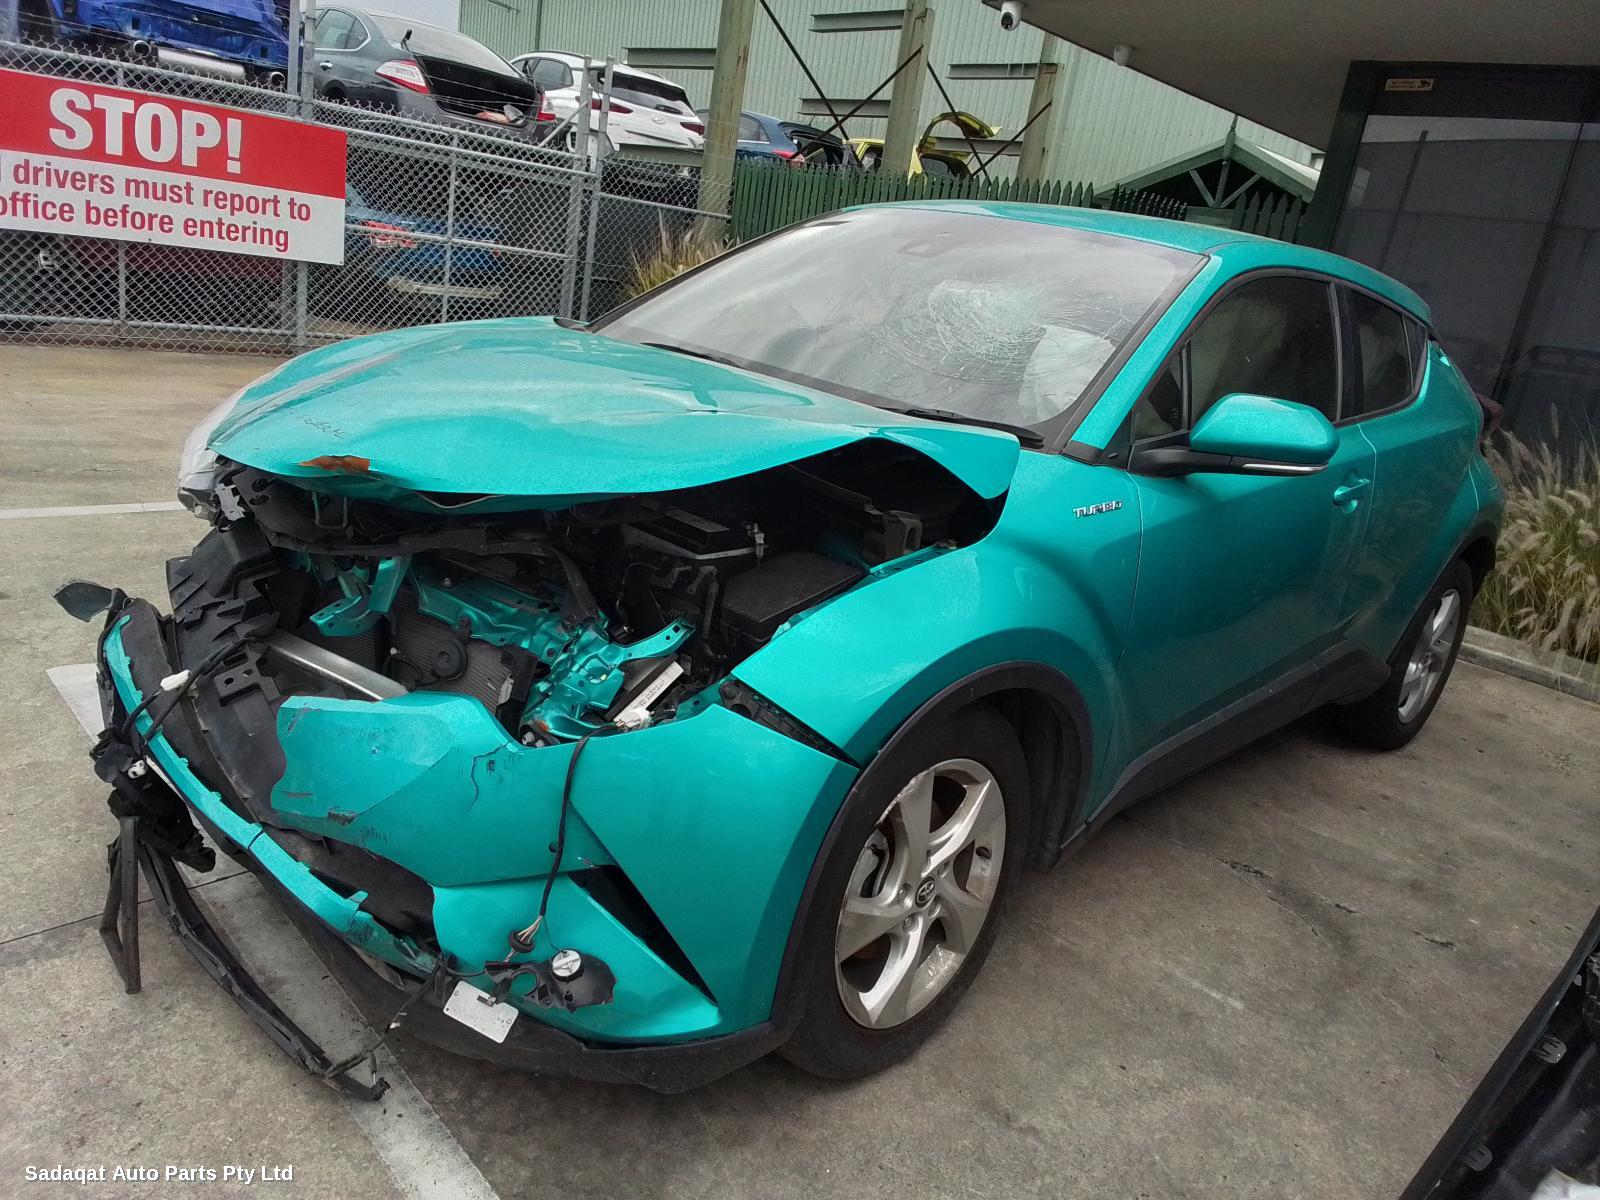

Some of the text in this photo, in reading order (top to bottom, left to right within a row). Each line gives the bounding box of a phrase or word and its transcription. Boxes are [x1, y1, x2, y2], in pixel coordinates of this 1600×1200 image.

[49, 87, 242, 174] STOP!
[13, 159, 312, 222] drivers must report to
[85, 200, 174, 234] before
[183, 215, 289, 253] entering
[1073, 500, 1123, 519] TURBO
